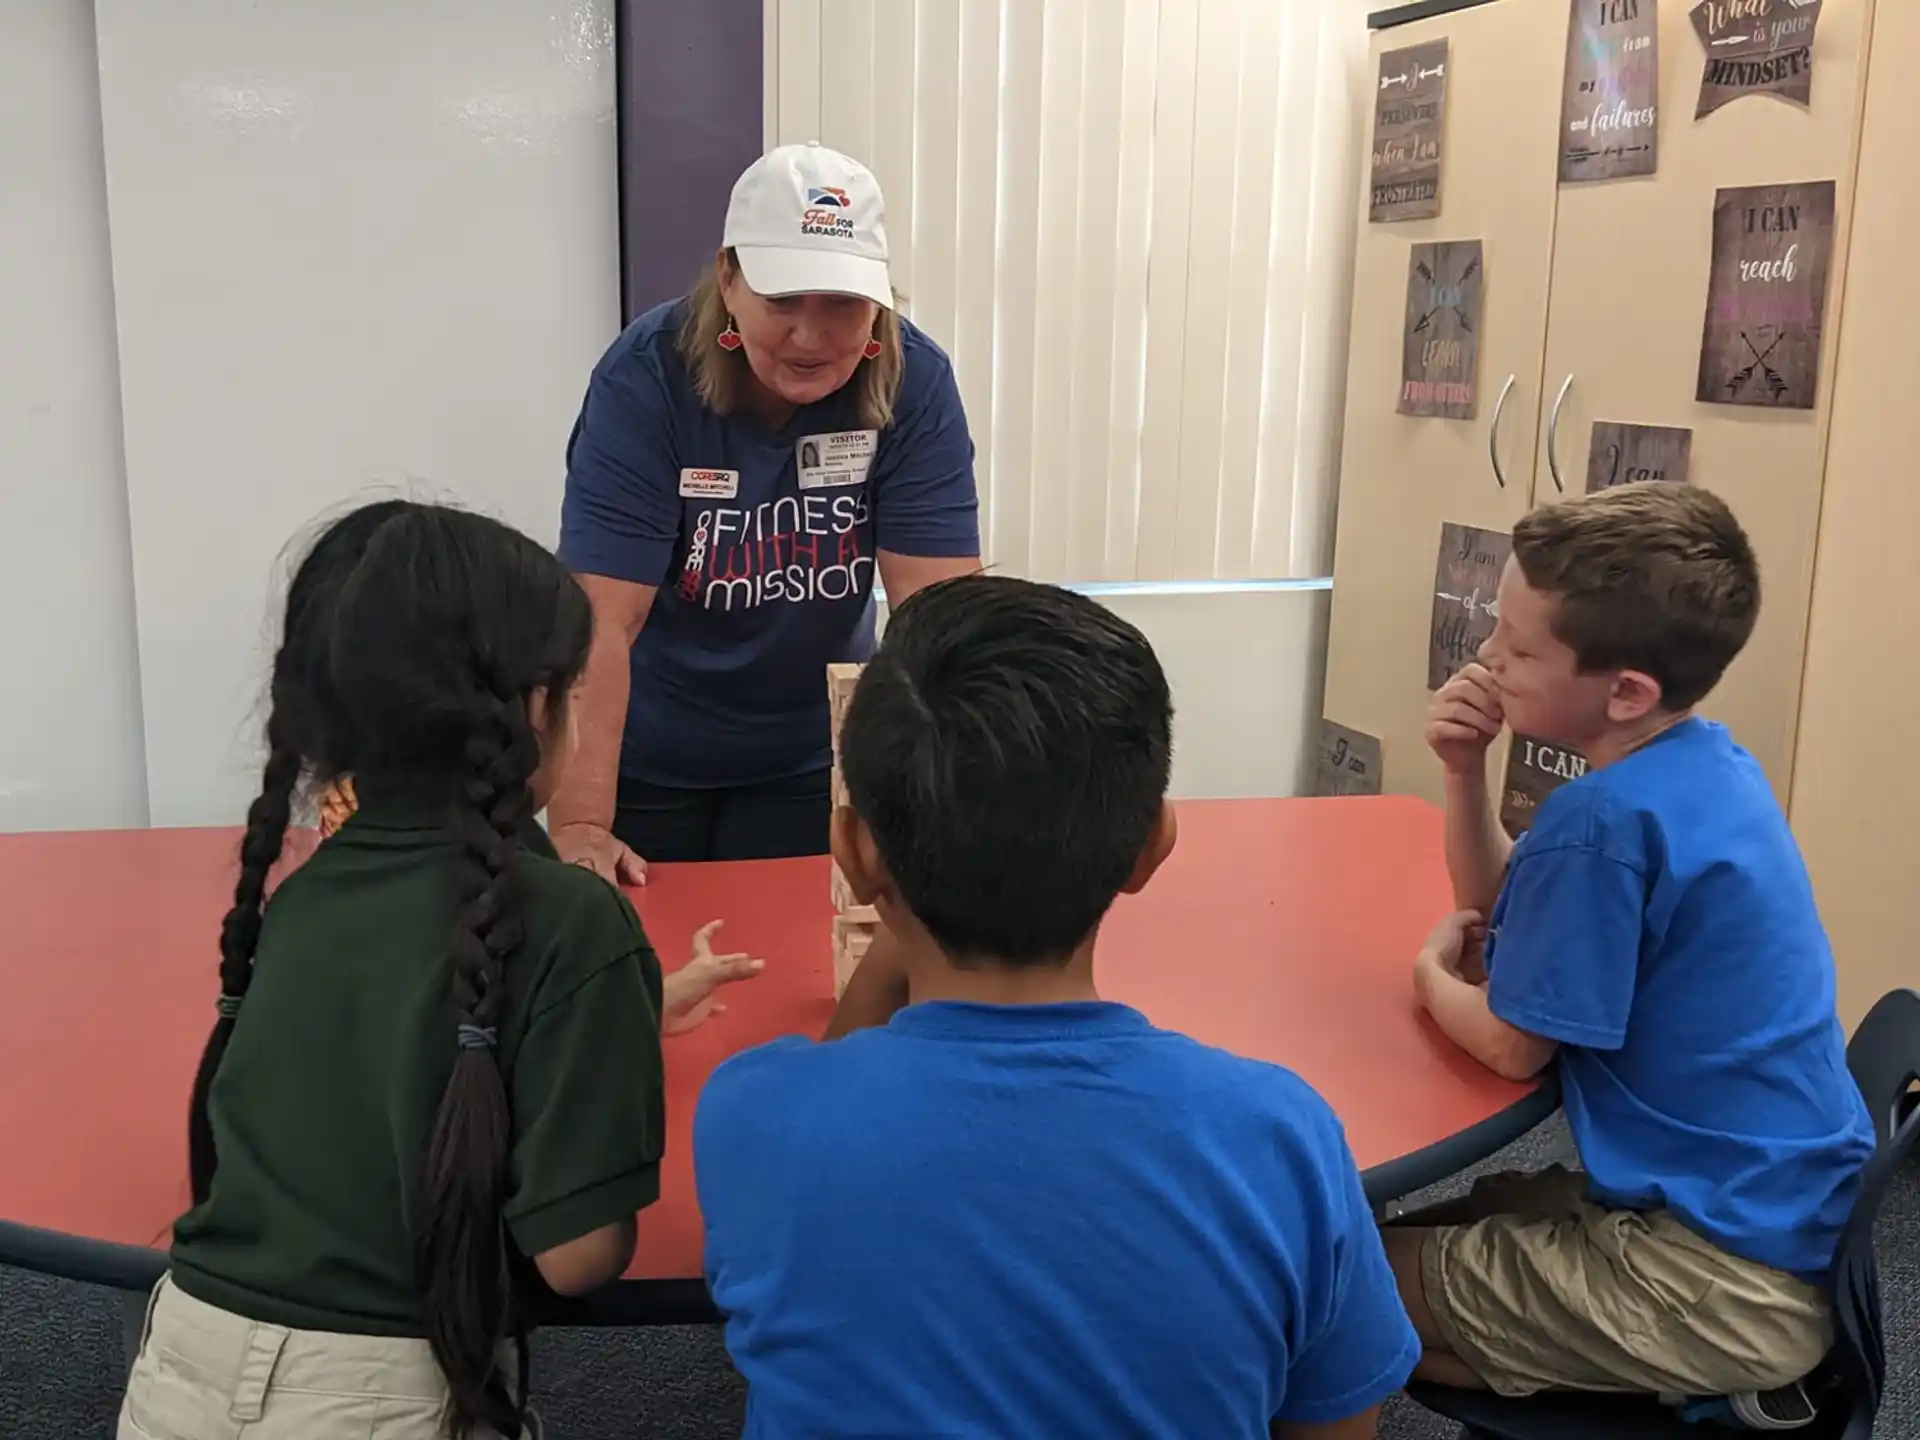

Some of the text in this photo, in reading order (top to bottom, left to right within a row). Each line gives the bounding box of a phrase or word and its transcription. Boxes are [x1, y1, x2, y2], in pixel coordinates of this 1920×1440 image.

[1610, 0, 1638, 25] CAN
[1622, 36, 1650, 53] from
[1753, 16, 1809, 52] is your
[1704, 45, 1809, 87] MINDSET?
[1590, 99, 1655, 137] failures
[801, 225, 853, 239] SARASOTA
[802, 208, 853, 229] Fall FOR
[1747, 206, 1800, 233] I CAN
[1740, 244, 1799, 282] reach
[830, 434, 867, 444] VISITOR
[1463, 588, 1480, 620] of
[1524, 740, 1587, 780] I CAN
